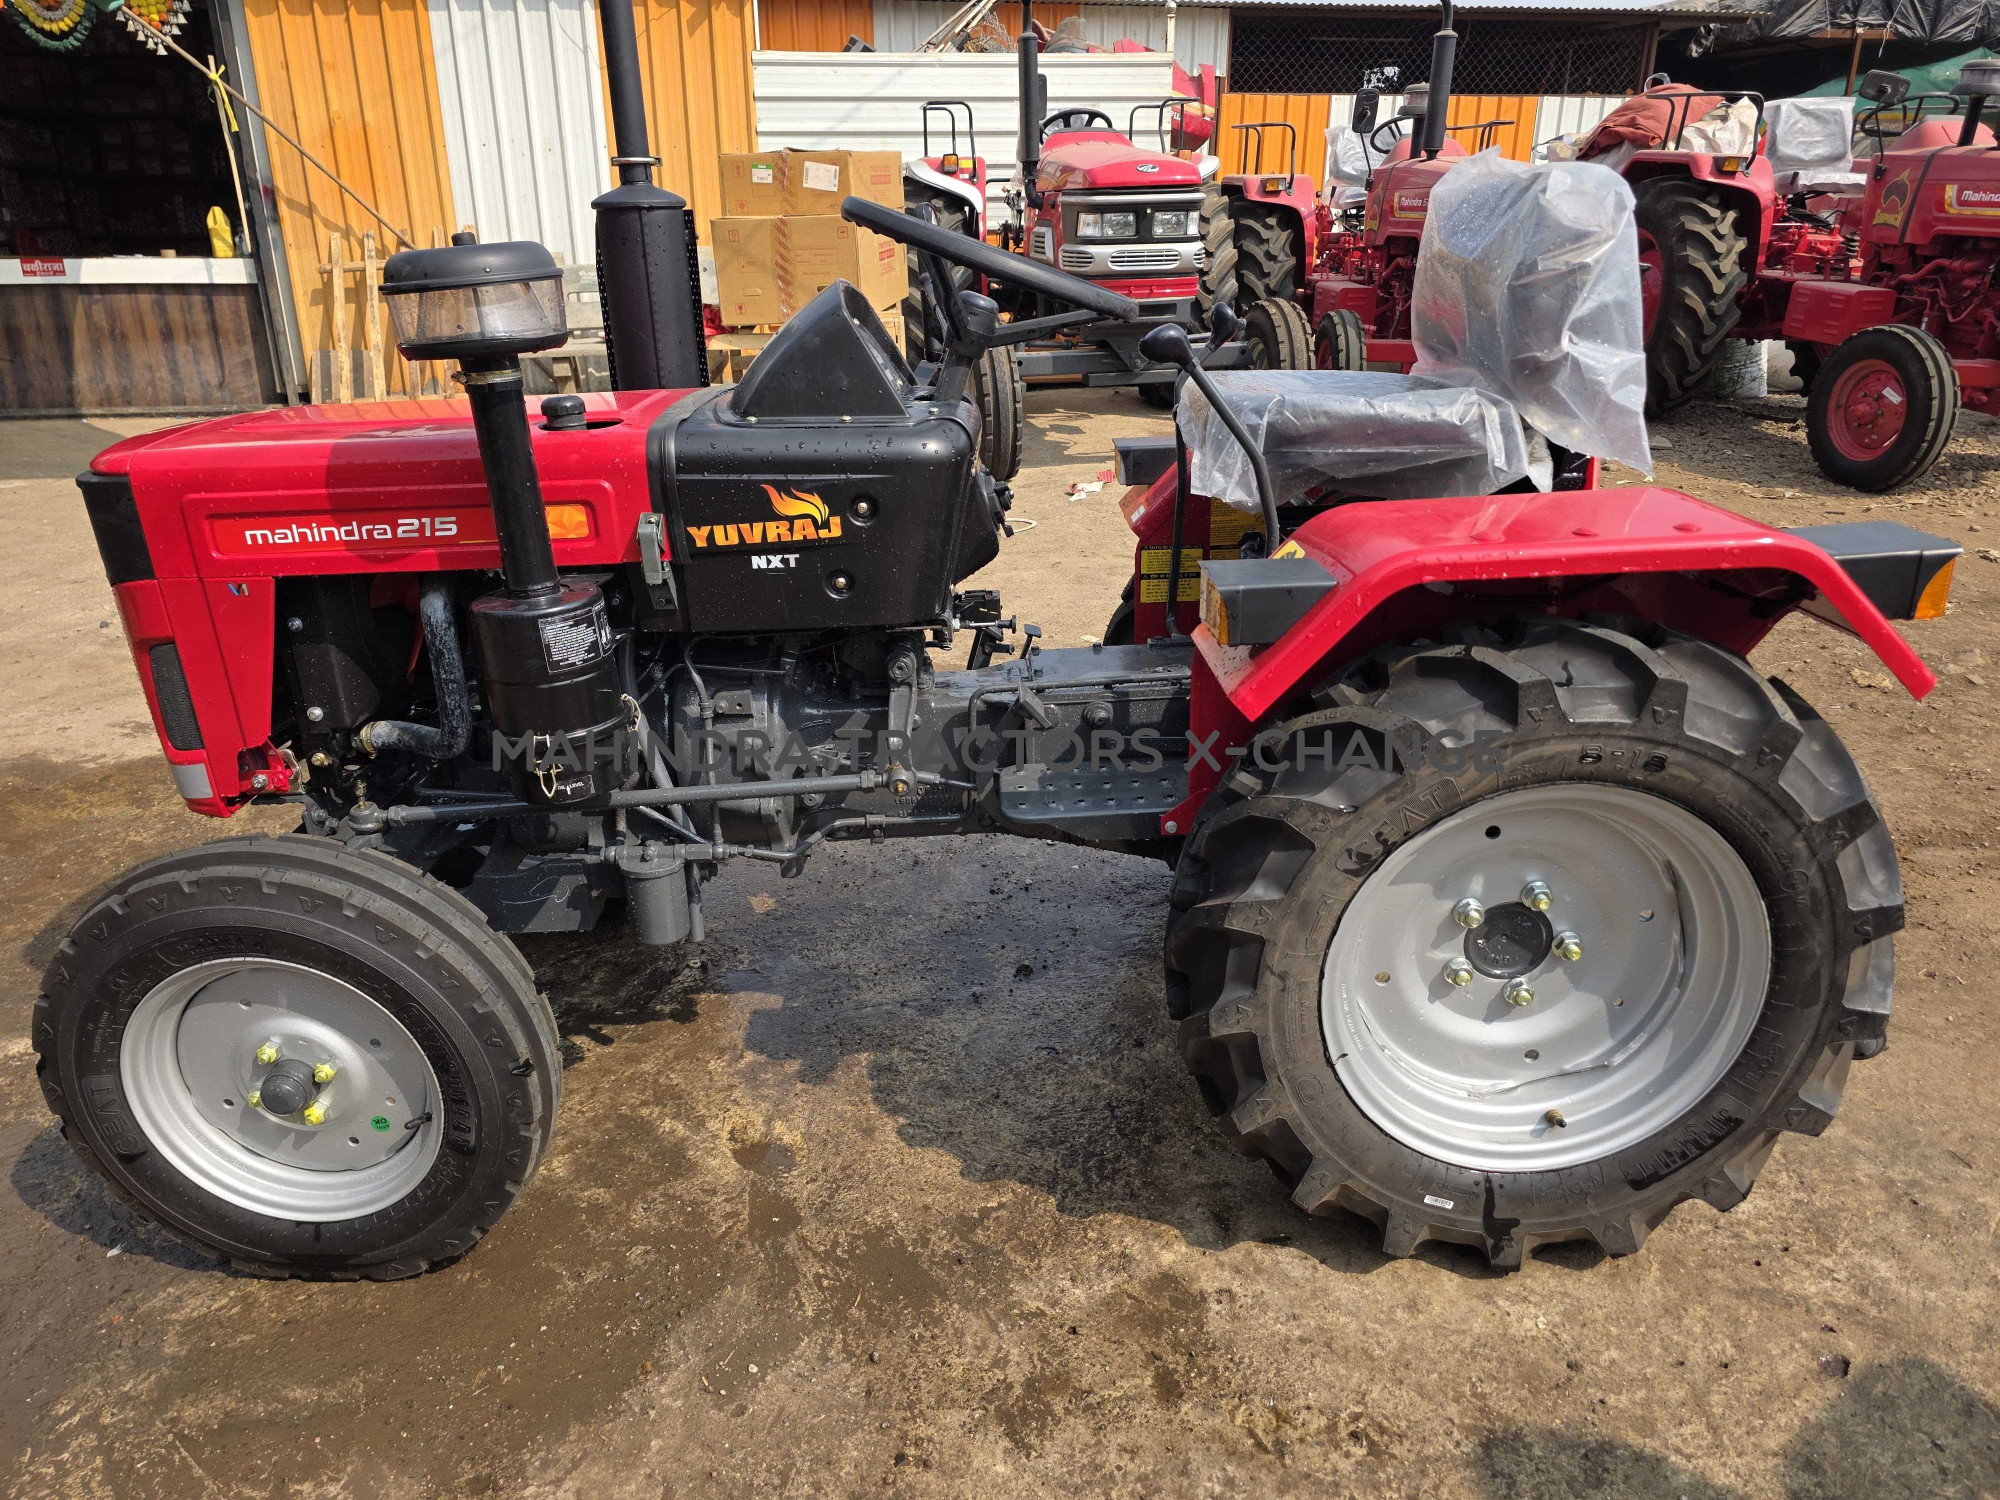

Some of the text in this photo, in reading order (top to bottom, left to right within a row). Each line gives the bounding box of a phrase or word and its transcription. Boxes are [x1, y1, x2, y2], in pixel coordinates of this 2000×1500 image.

[244, 516, 458, 545] mahindra 215
[686, 515, 843, 548] YUVRAJ
[751, 553, 800, 570] NXT
[1350, 784, 1444, 866] CEAT
[88, 1083, 139, 1154] CEAT
[372, 1117, 387, 1125] OK
